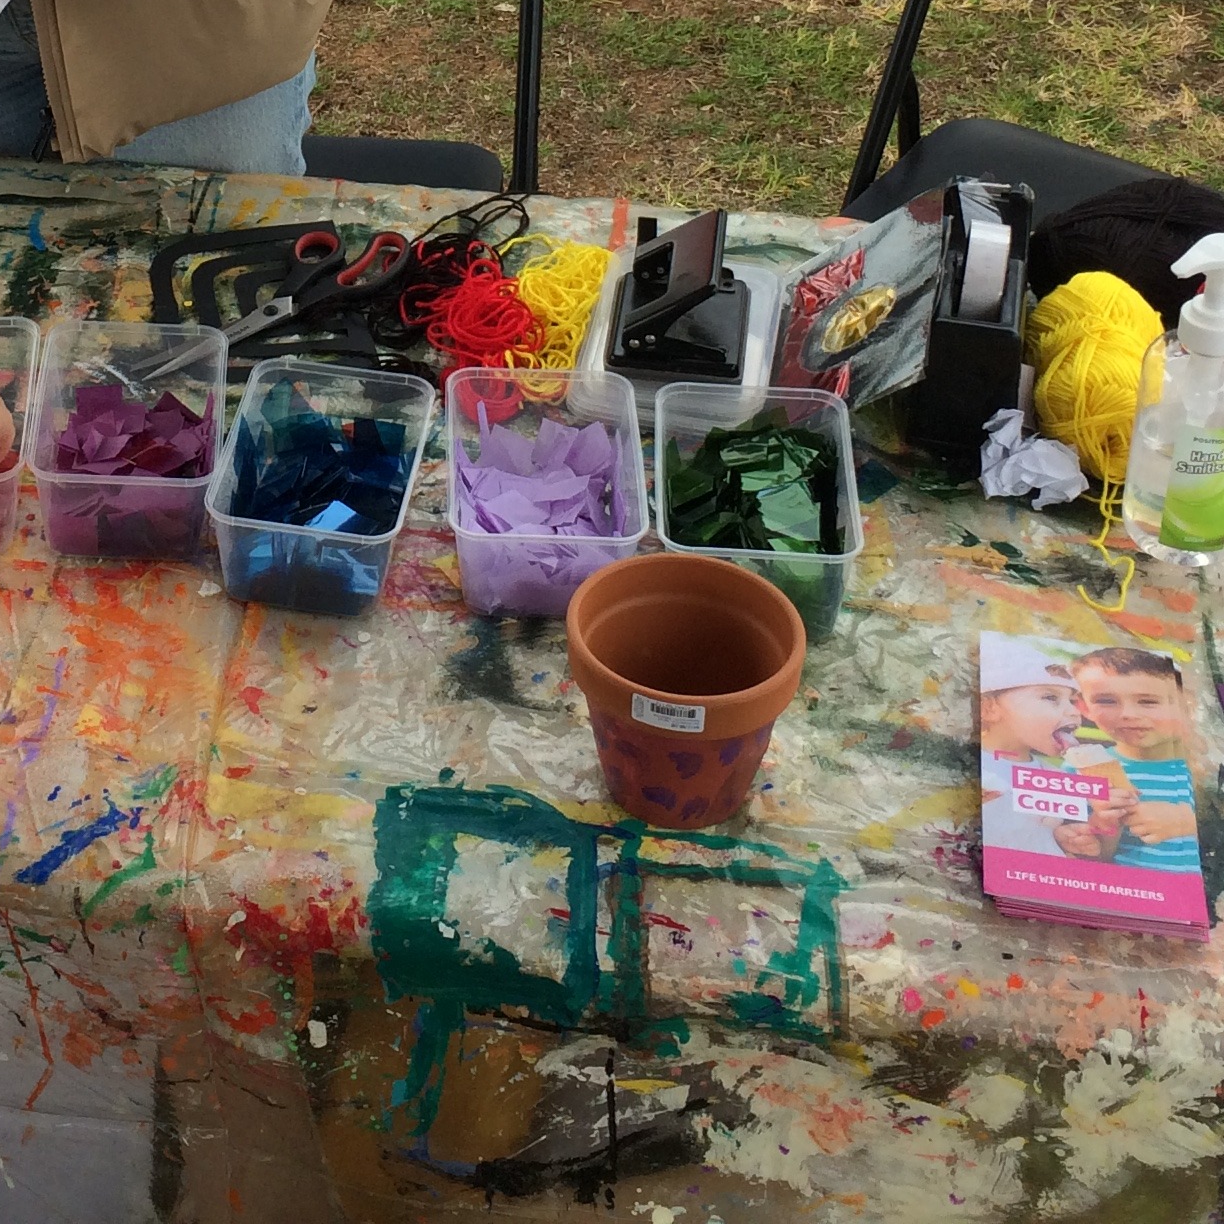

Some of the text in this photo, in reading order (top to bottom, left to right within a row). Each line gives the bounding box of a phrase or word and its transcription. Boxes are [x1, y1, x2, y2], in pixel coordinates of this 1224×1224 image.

[1016, 769, 1104, 796] Foster
[1017, 793, 1080, 816] Care
[1005, 869, 1166, 902] LIFE WITHOUT BARRIERS
